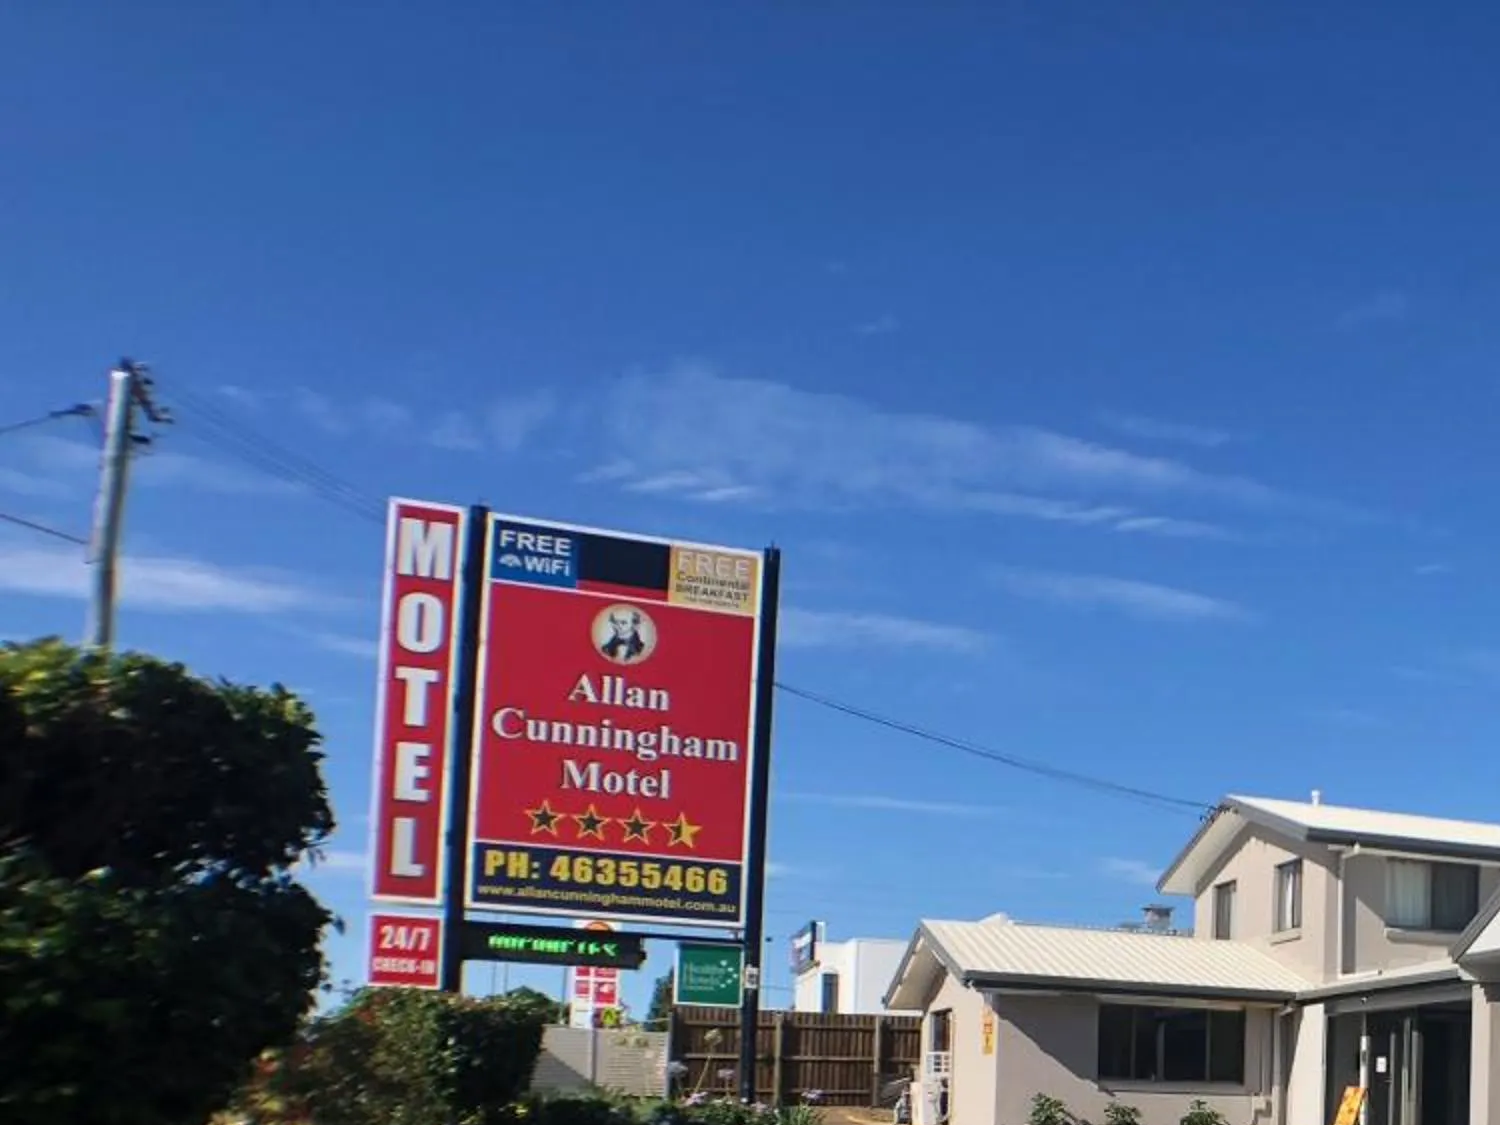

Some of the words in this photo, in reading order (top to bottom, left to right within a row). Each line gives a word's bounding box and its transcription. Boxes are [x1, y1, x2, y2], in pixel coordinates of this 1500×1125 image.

[500, 529, 571, 557] FREE
[524, 554, 570, 577] WiFi
[678, 551, 750, 579] FREE
[675, 582, 749, 602] BREAKFAST
[676, 571, 750, 590] Continental
[389, 517, 453, 877] MOTEL
[568, 673, 670, 711] Allan
[491, 707, 738, 761] Cunningham
[561, 759, 670, 799] Motel
[484, 849, 541, 880] PH:
[549, 855, 729, 895] 46355466
[477, 884, 737, 914] www.allancunninghammotel.com.au
[379, 925, 433, 951] 24/7
[371, 957, 436, 975] CHECK-IN
